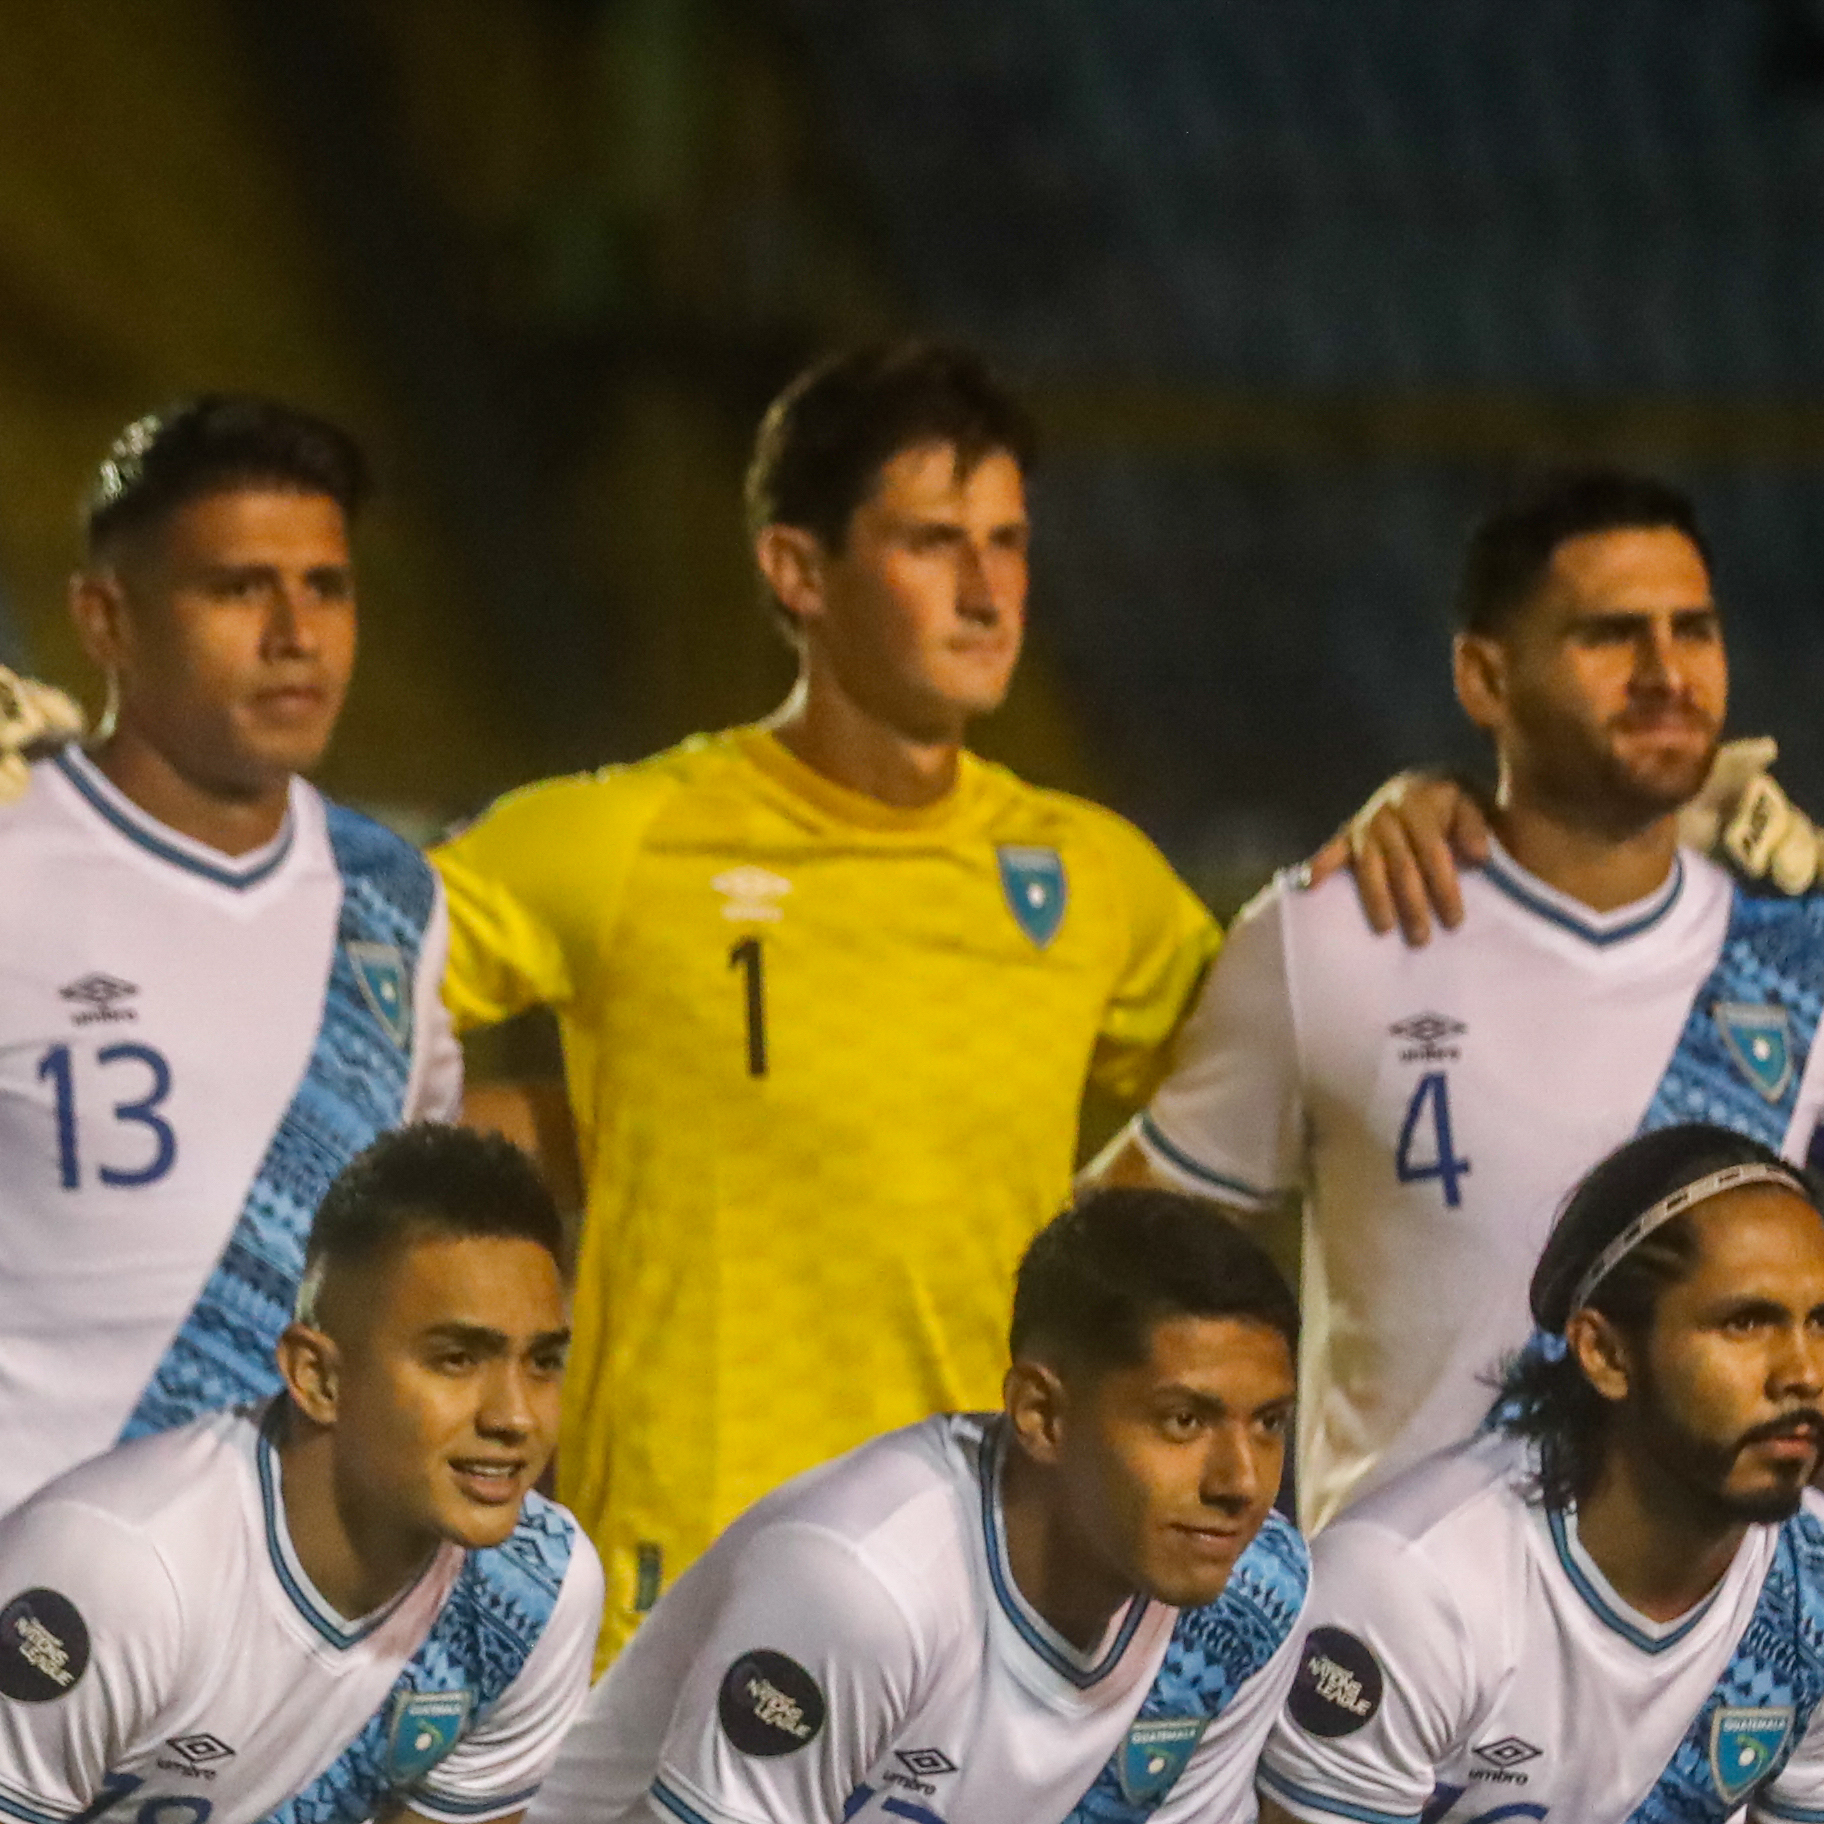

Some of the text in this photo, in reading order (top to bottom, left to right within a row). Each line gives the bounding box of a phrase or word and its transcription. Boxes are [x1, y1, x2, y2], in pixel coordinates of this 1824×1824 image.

[729, 937, 768, 1077] 1
[38, 1045, 178, 1187] 13
[1396, 1072, 1469, 1207] 4
[1469, 1769, 1528, 1786] umbro
